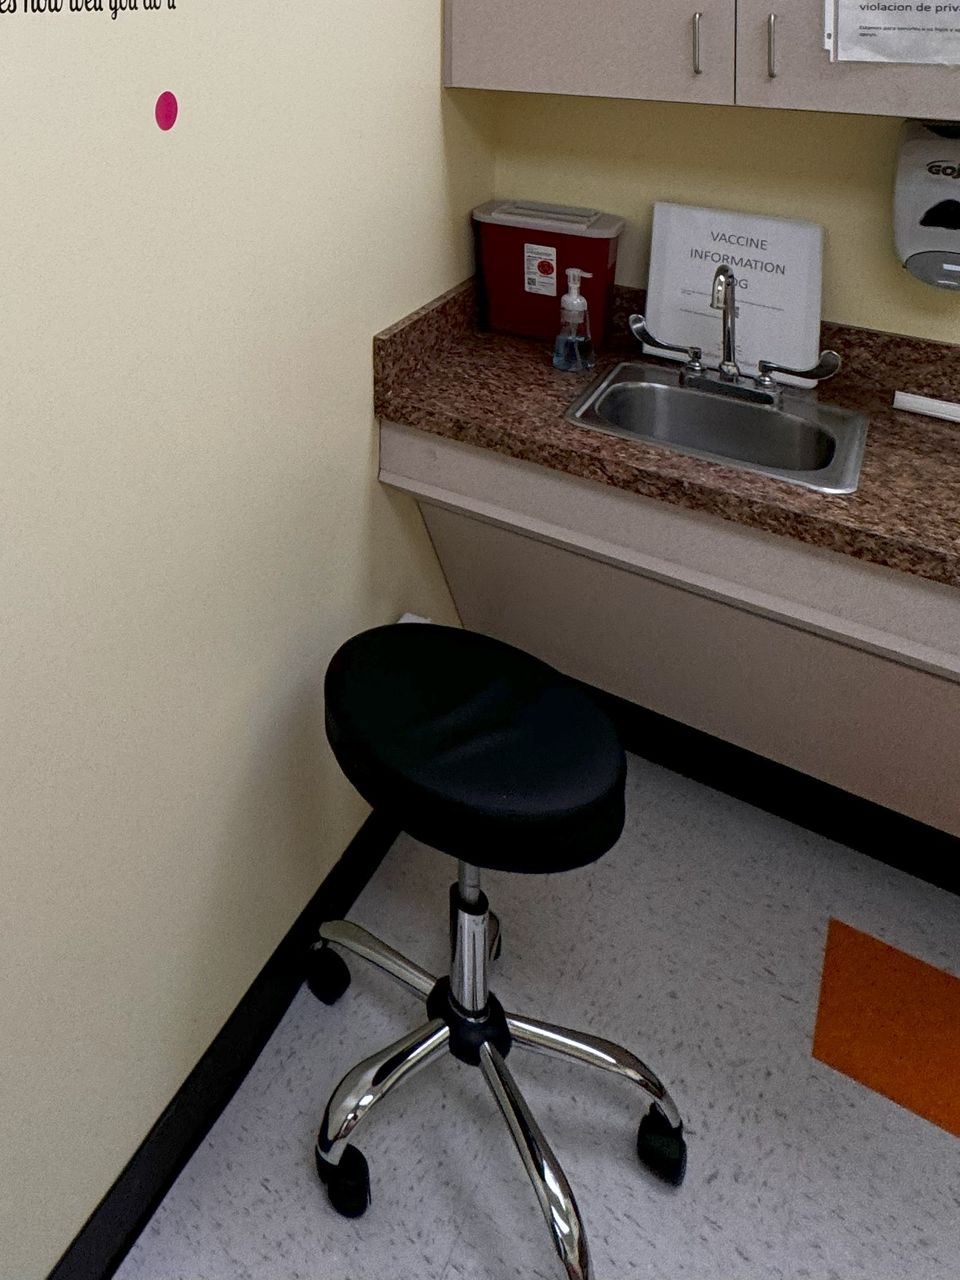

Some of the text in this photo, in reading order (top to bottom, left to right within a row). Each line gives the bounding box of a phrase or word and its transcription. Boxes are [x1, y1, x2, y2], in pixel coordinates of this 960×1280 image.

[859, 1, 912, 12] violacion
[915, 2, 931, 12] de
[711, 231, 769, 251] VACCINE
[690, 248, 786, 275] INFORMATION
